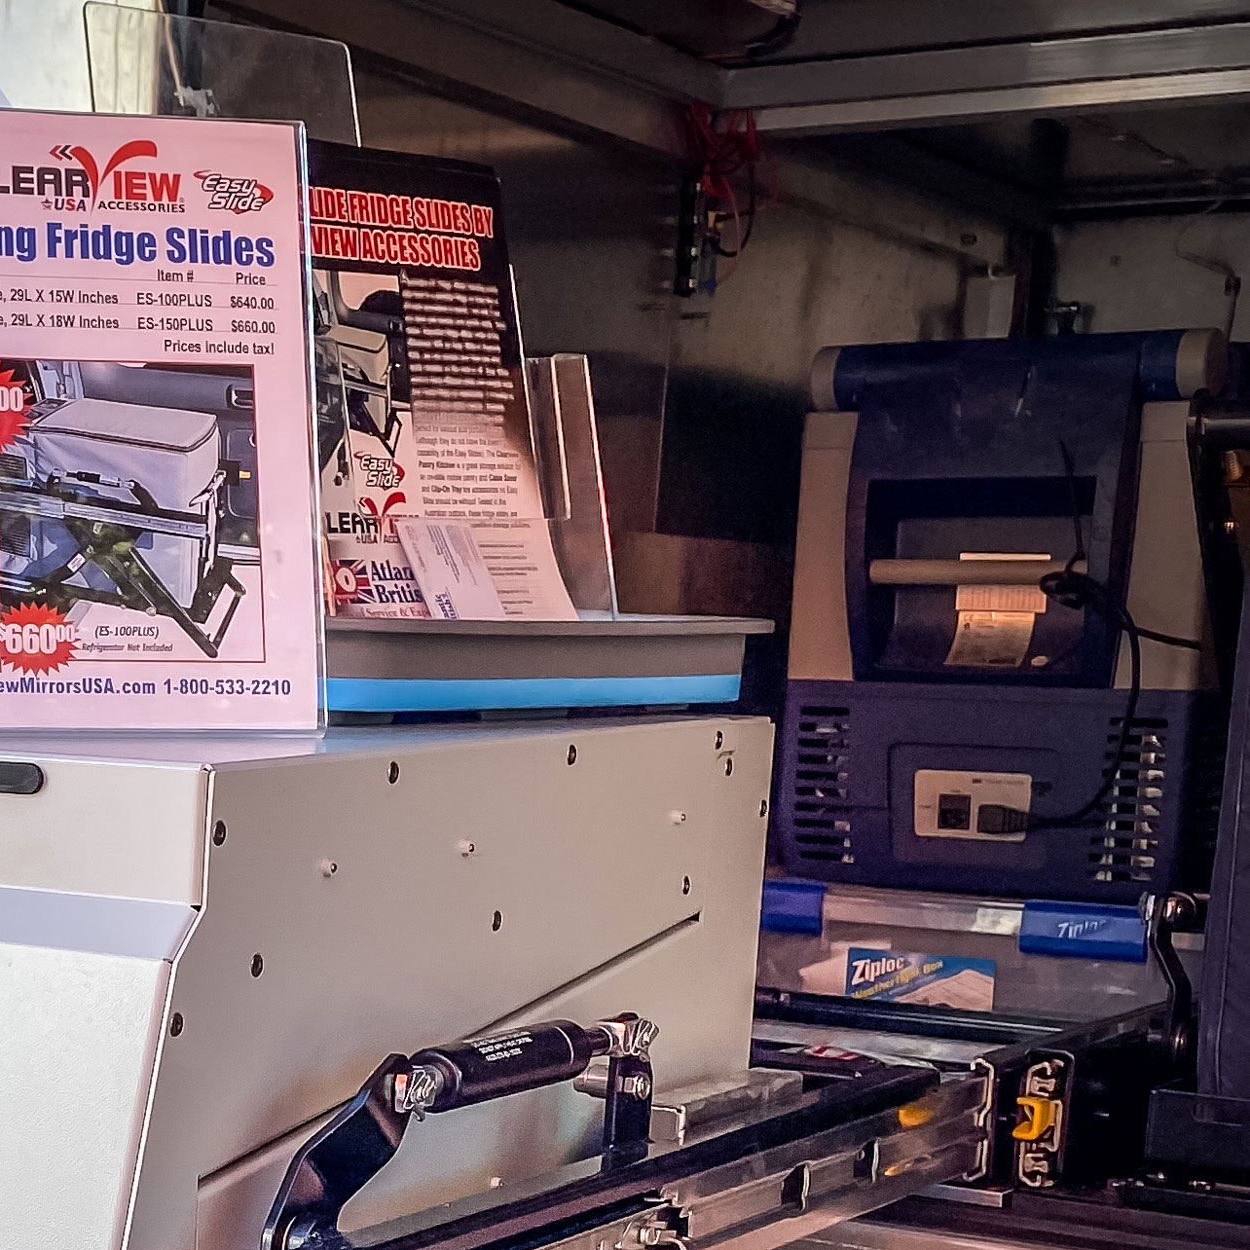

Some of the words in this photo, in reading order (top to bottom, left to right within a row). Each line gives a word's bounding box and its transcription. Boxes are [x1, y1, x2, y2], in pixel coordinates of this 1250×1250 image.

[201, 174, 257, 196] Easy
[54, 198, 86, 211] USA
[98, 200, 185, 213] ACCESSORIES
[208, 192, 264, 211] Slide
[347, 190, 415, 229] FRIDGE
[413, 197, 473, 236] SLIDES
[471, 204, 494, 238] BY
[47, 222, 157, 266] Fridge
[165, 227, 275, 267] Slides
[360, 228, 482, 271] ACCESSORIES
[157, 269, 184, 282] Item
[187, 270, 194, 282] #
[235, 272, 266, 285] Price
[10, 289, 32, 301] 29L
[35, 289, 44, 302] X
[48, 290, 74, 303] 15W
[78, 290, 118, 304] Inches
[136, 292, 212, 307] ES-100PLUS
[230, 296, 274, 309] $640.00
[11, 313, 33, 326] 29L
[36, 314, 46, 327] X
[49, 315, 75, 328] 18W
[79, 315, 119, 328] Inches
[137, 317, 213, 331] ES-150PLUS
[231, 320, 275, 333] $660.00
[164, 340, 201, 352] Prices
[206, 341, 249, 354] include
[252, 343, 274, 355] tax!
[360, 454, 394, 471] Easy
[366, 471, 401, 487] Slide
[94, 625, 160, 639] (ES-100PLUS)
[163, 678, 292, 696] 1-800-533-2210
[851, 956, 906, 986] Ziploc
